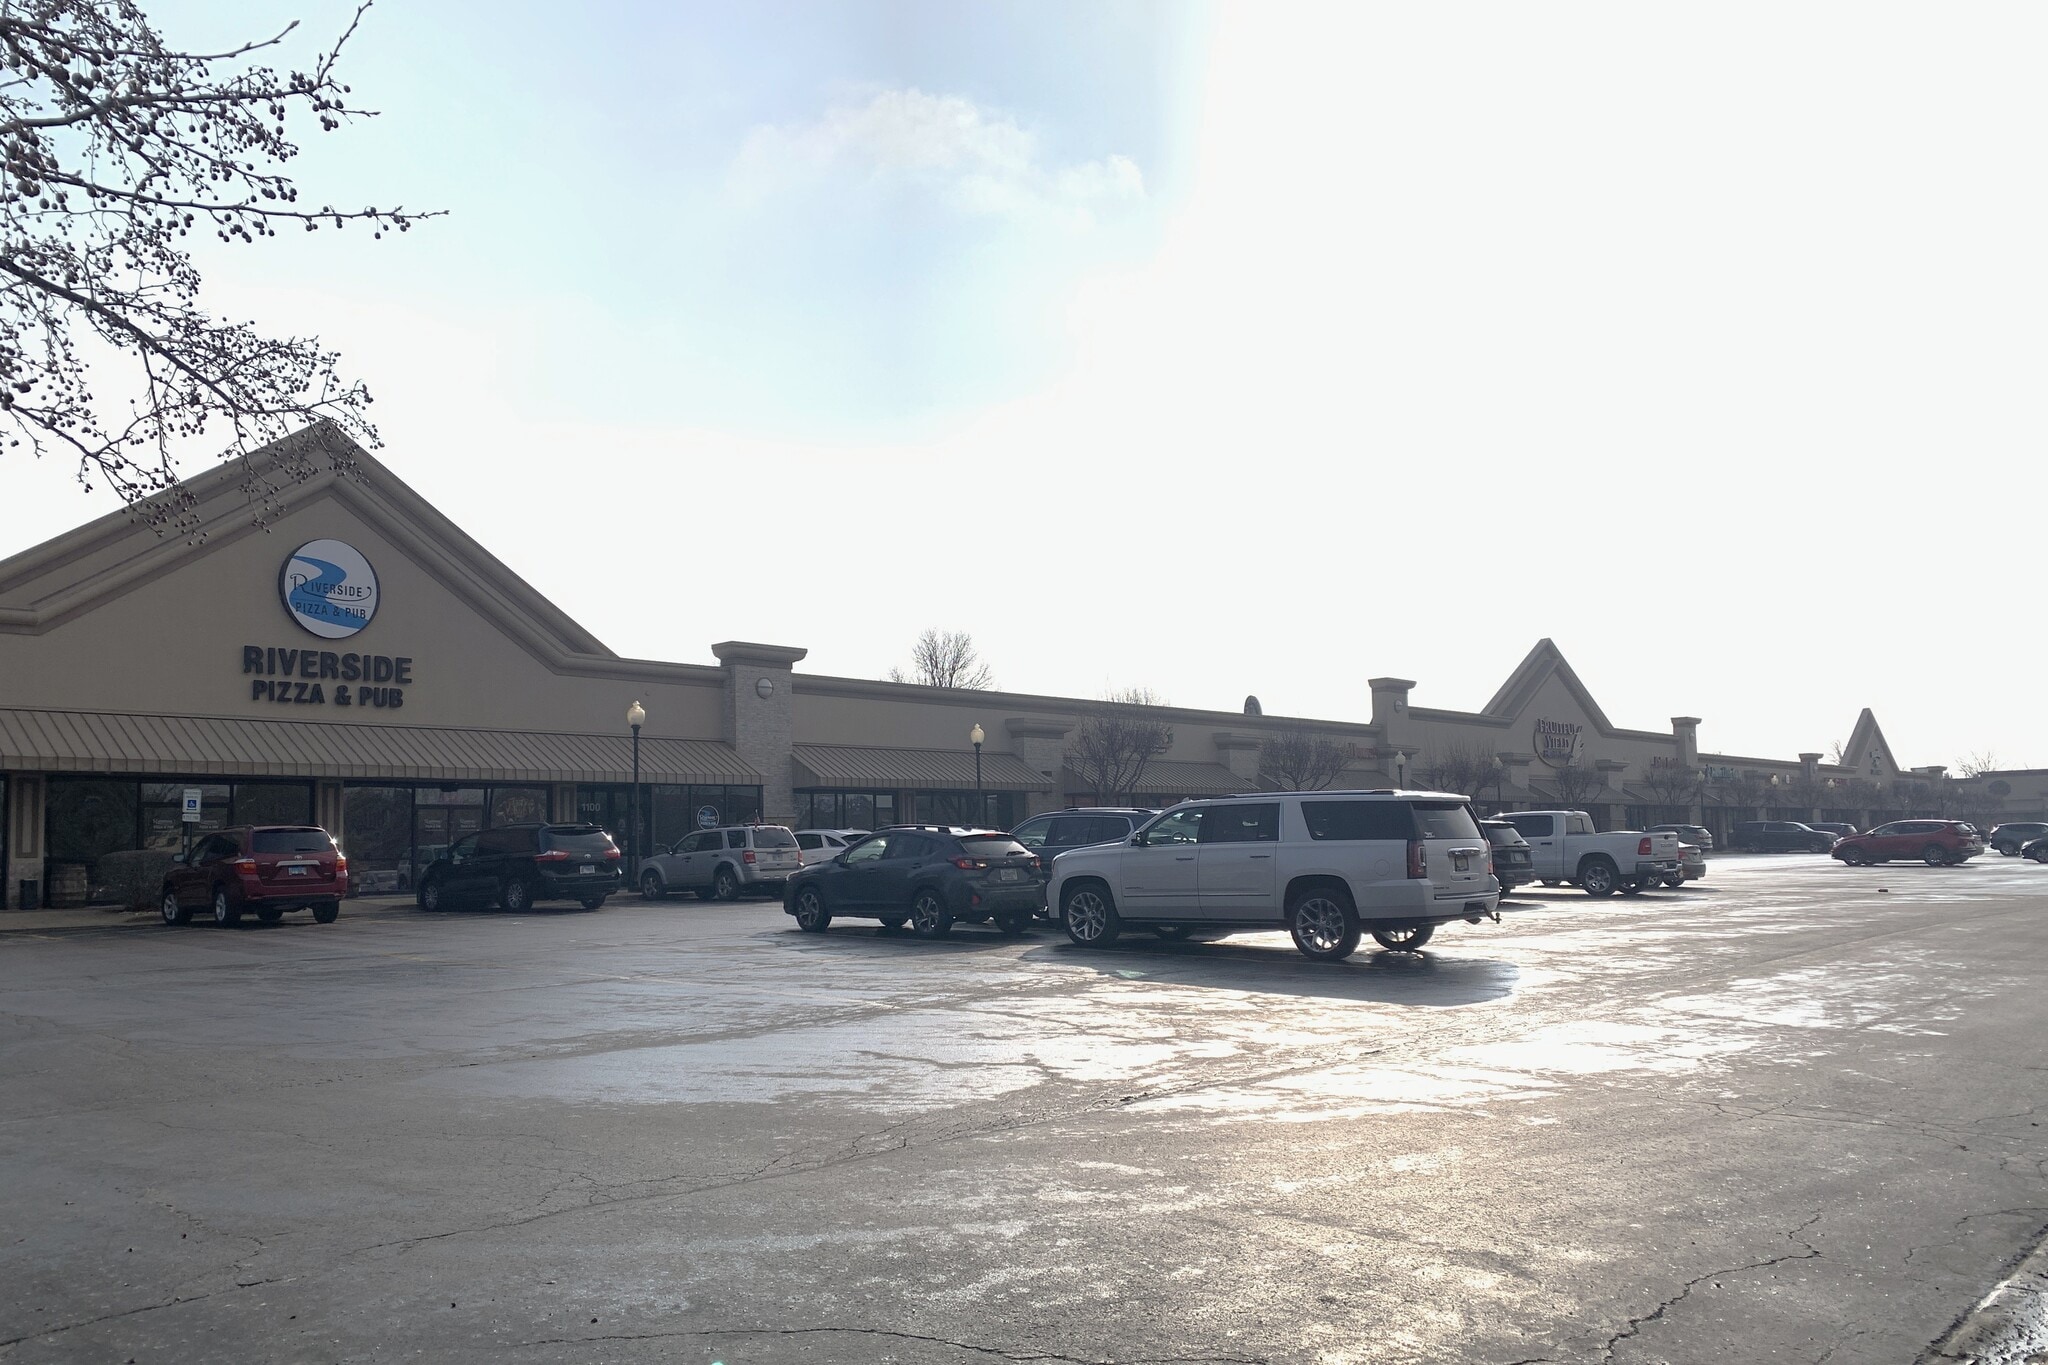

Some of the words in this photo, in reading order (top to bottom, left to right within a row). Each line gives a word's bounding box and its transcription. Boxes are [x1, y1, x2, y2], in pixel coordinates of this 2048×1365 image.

[290, 573, 371, 601] RIVERSIDE
[295, 602, 328, 615] PIZZA
[333, 606, 341, 617] &
[345, 608, 366, 619] PUB
[243, 645, 413, 684] RIVERSIDE
[252, 679, 325, 704] PIZZA
[334, 685, 351, 706] &
[359, 686, 404, 708] PUB
[1544, 735, 1569, 749] YIELD
[581, 802, 601, 812] 1100
